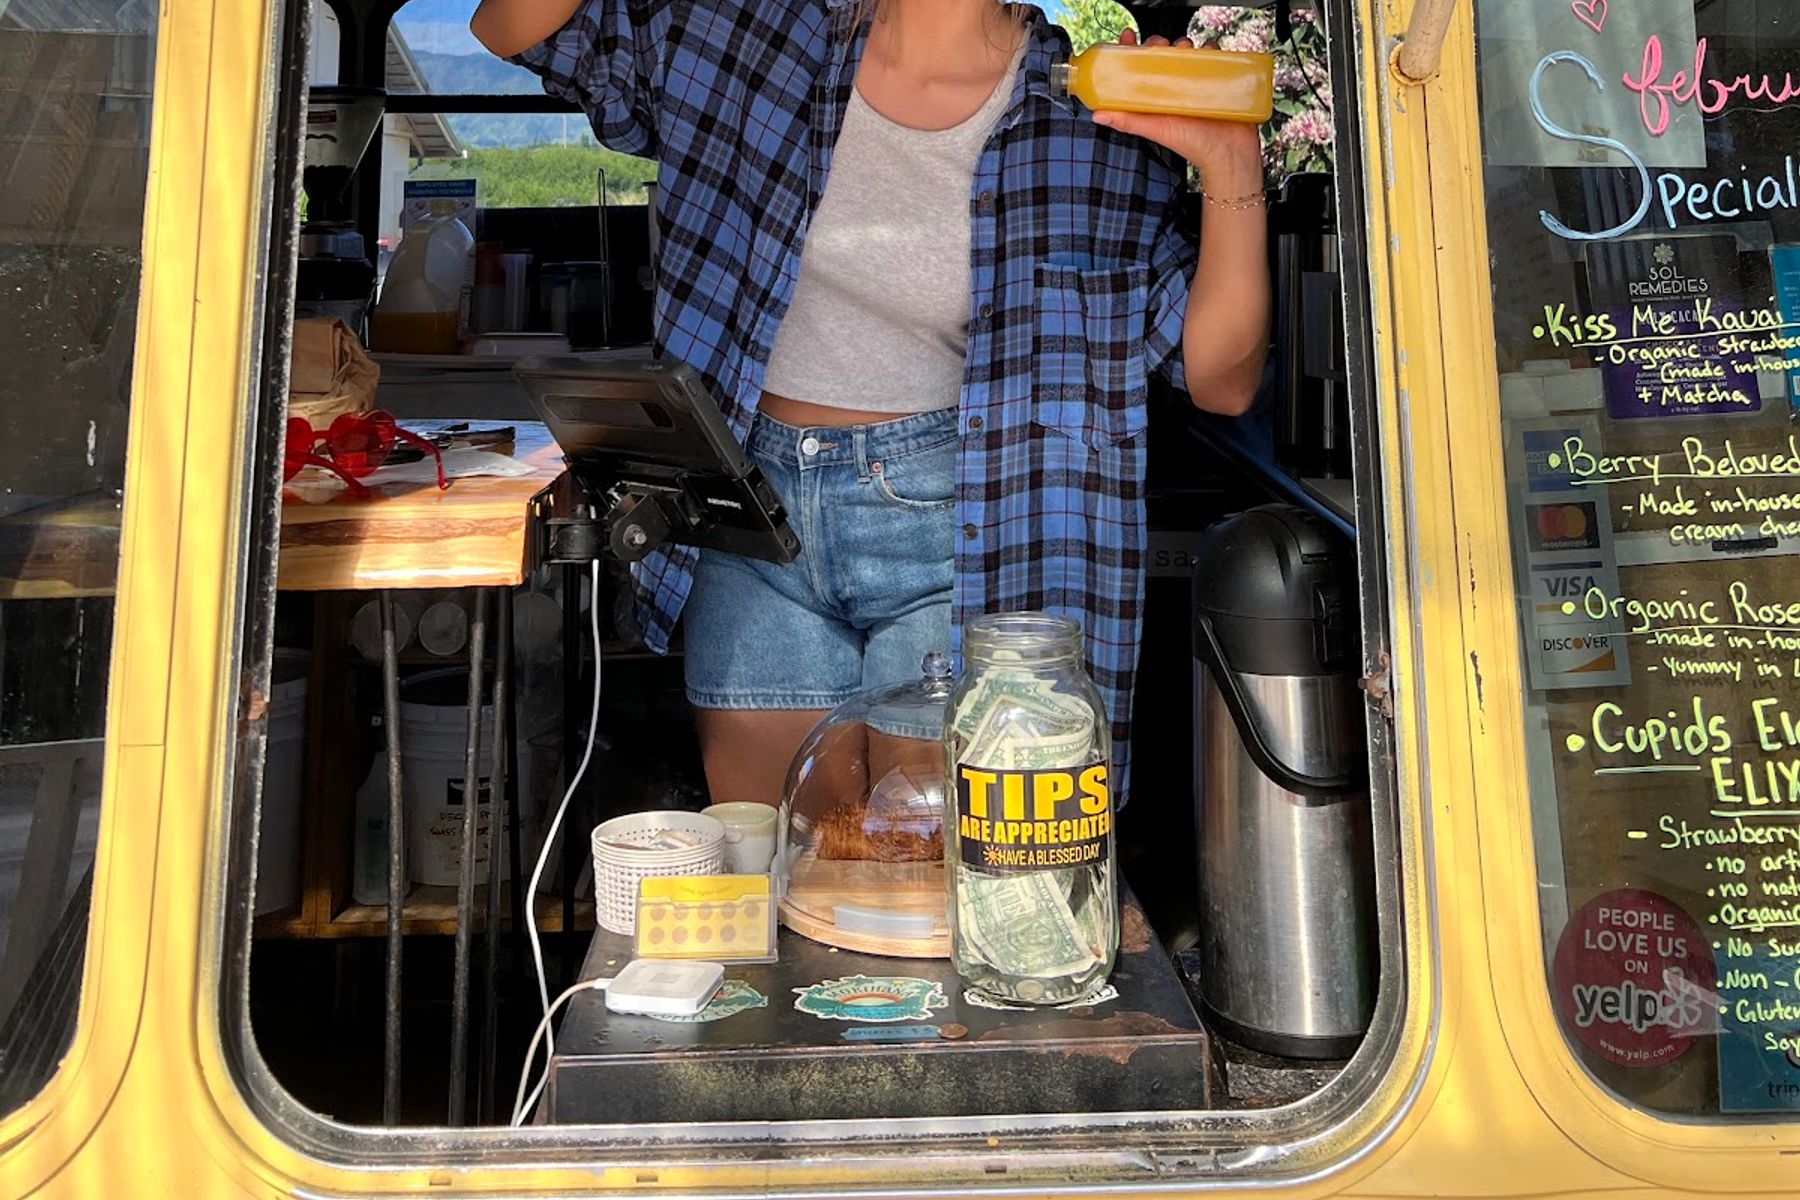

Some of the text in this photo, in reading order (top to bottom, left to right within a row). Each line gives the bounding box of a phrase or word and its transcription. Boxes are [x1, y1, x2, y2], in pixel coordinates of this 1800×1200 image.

[1529, 50, 1800, 240] Special
[1649, 266, 1684, 281] SOL
[1629, 278, 1709, 296] REMEDIES
[1544, 303, 1617, 346] Kiss
[1632, 304, 1676, 337] Me
[1609, 342, 1700, 370] Organic
[1661, 383, 1751, 405] Matcha
[1563, 435, 1800, 485] Berry Beloved
[1640, 486, 1697, 515] Made
[1670, 514, 1800, 541] cream che
[1540, 576, 1597, 597] VISA
[1585, 581, 1800, 633] Organic Rose
[1543, 635, 1609, 651] DISCOVER
[1662, 656, 1742, 682] Yummy
[1753, 657, 1782, 677] in
[1592, 696, 1731, 760] Cupids
[961, 765, 1109, 820] TIPS
[960, 814, 991, 843] ARE
[999, 842, 1101, 866] HAVE A BLESSED DAY
[1716, 856, 1746, 874] no
[1719, 882, 1749, 898] no
[1599, 907, 1675, 931] PEOPLE
[1584, 929, 1688, 960] LOVE US
[1727, 937, 1754, 959] No
[1624, 959, 1649, 975] ON
[1572, 980, 1661, 1033] yelp
[1599, 1039, 1675, 1061] www.yelp.com
